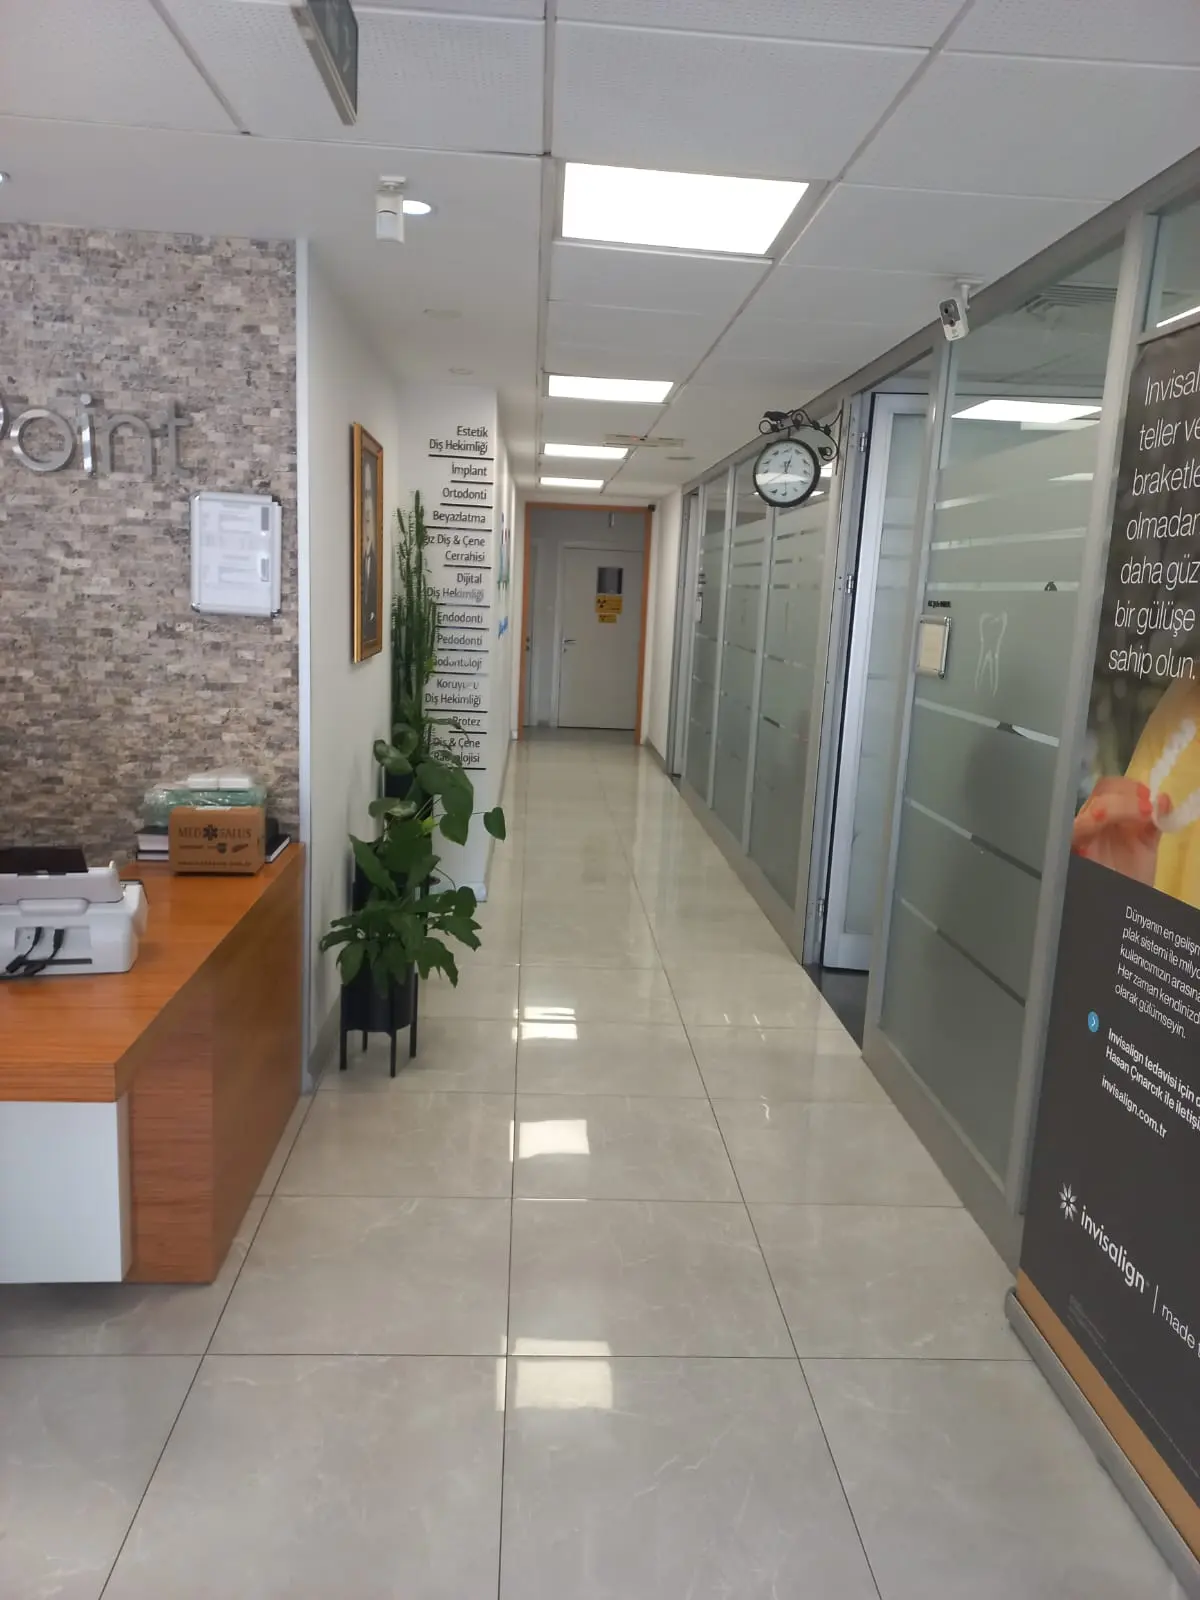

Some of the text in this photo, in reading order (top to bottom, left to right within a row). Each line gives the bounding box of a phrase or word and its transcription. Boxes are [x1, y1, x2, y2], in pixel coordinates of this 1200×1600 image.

[0, 393, 194, 479] oint
[456, 426, 489, 438] Estetik
[1139, 417, 1182, 452] teller
[429, 439, 488, 456] Diş Hekimliği
[442, 488, 488, 500] Ortodonti
[432, 511, 486, 524] Beyazlatma
[437, 533, 451, 547] Diş
[453, 534, 460, 545] &
[462, 535, 486, 548] Çene
[445, 550, 486, 562] Cerrahisi
[456, 572, 483, 586] Dijital
[1120, 555, 1163, 585] daha
[427, 586, 441, 599] Diş
[437, 611, 483, 625] Endodonti
[1114, 599, 1196, 638] bir gülüşe
[437, 634, 483, 646] Pedodonti
[1108, 644, 1196, 680] sahip olun.
[436, 678, 480, 692] Koruyuu
[424, 693, 482, 708] Diş Hekimliği
[449, 737, 457, 747] &
[458, 737, 481, 751] Çene
[1125, 905, 1163, 936] Dünyanın
[1163, 928, 1174, 942] en
[1122, 927, 1141, 945] plak
[1140, 935, 1169, 961] sistemi
[1168, 949, 1179, 966] ile
[1117, 961, 1133, 981] Her
[1132, 974, 1159, 999] zaman
[1115, 983, 1186, 1040] olarak gülümseyin.
[1108, 1027, 1195, 1103] Invisalign tedavisi için
[1105, 1044, 1130, 1074] Hasan
[1130, 1065, 1163, 1101] Çınarcık
[1163, 1090, 1175, 1110] ile
[1101, 1074, 1167, 1139] invisalign.com.tr
[1081, 1204, 1145, 1294] invisalign
[1161, 1304, 1195, 1349] made
